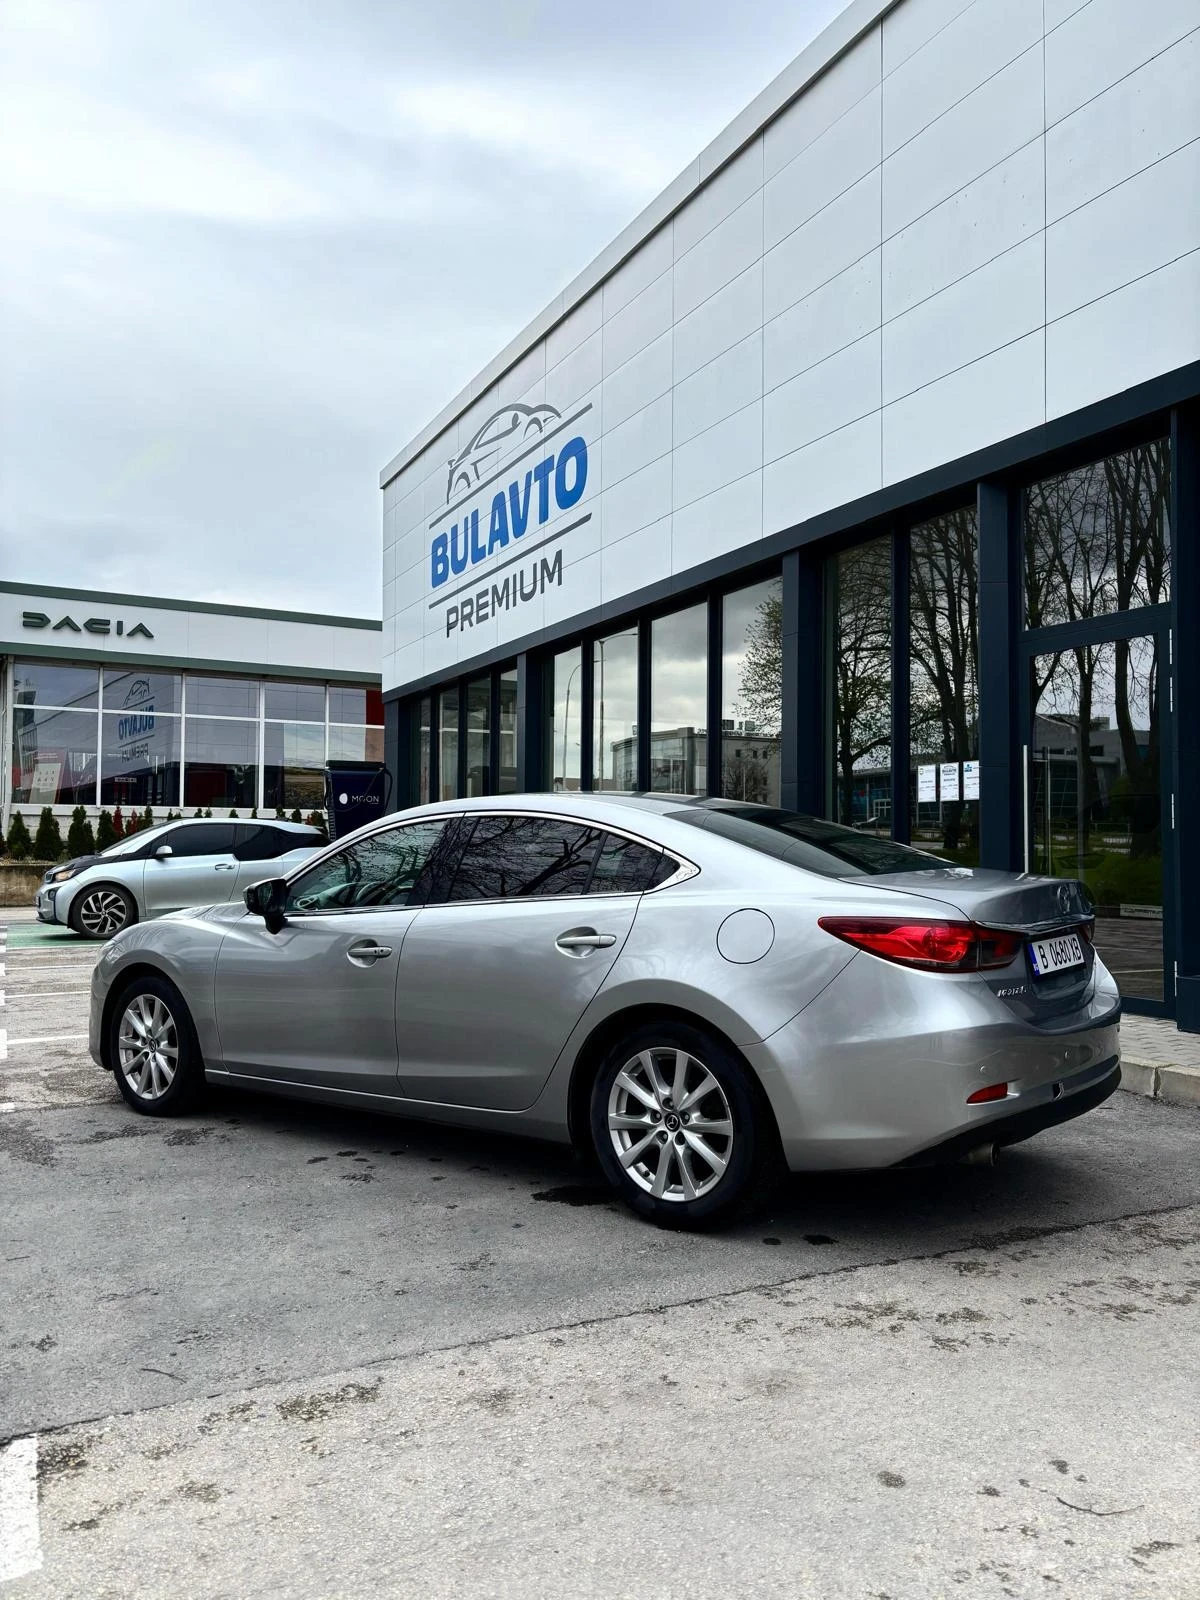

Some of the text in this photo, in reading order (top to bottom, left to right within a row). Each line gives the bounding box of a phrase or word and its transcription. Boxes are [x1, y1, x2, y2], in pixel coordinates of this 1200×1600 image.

[431, 436, 588, 589] BULAVTO
[446, 549, 563, 638] PREMIUM
[22, 611, 155, 639] DACIA
[1038, 944, 1048, 969] B
[1049, 941, 1071, 966] 0680
